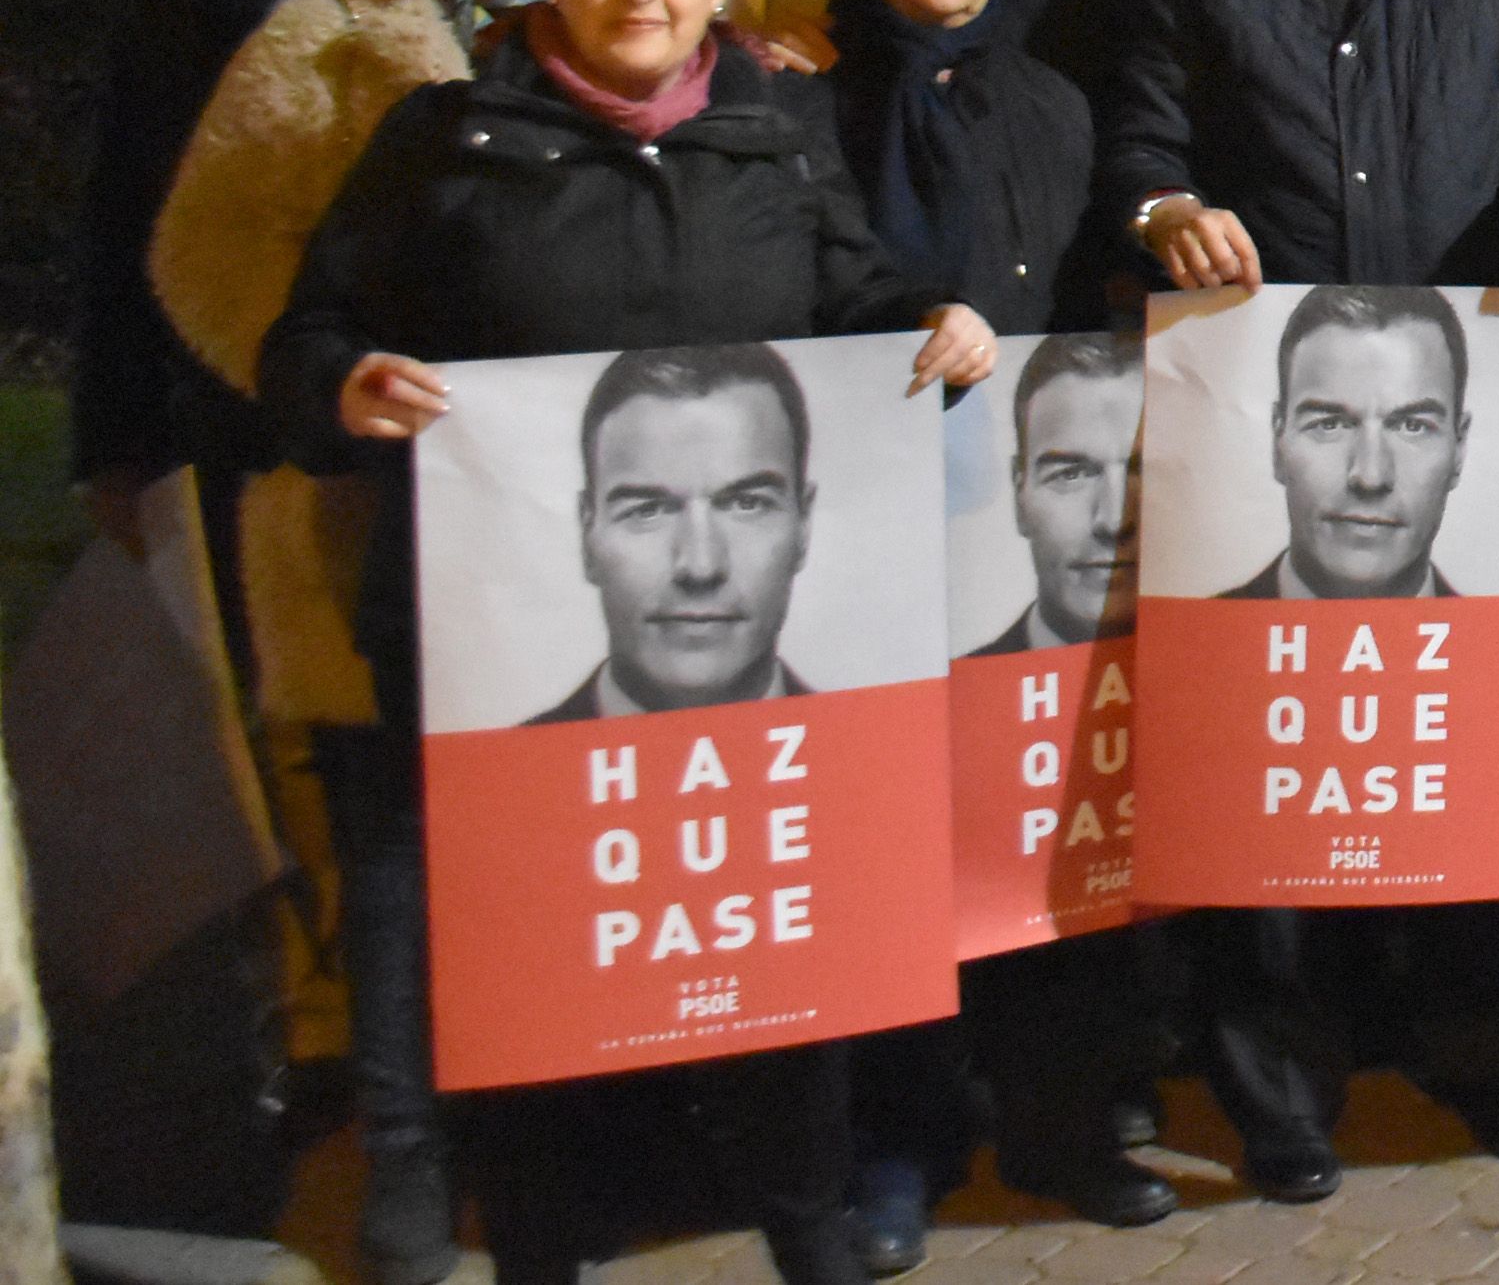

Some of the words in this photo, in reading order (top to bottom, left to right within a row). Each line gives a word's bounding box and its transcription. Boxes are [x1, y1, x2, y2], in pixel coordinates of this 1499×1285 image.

[1268, 623, 1450, 672] HAZ
[1022, 662, 1132, 722] HA
[1267, 693, 1448, 744] QUE
[589, 724, 808, 804] HAZ
[1022, 728, 1128, 787] QU
[1264, 764, 1446, 815] PASE
[593, 805, 810, 884] QUE
[1023, 791, 1136, 855] PAS
[1331, 836, 1381, 847] VOTA
[1330, 850, 1379, 869] PSOE
[595, 885, 813, 967] PASE
[678, 991, 740, 1020] PSOE
[680, 975, 740, 994] VOTA
